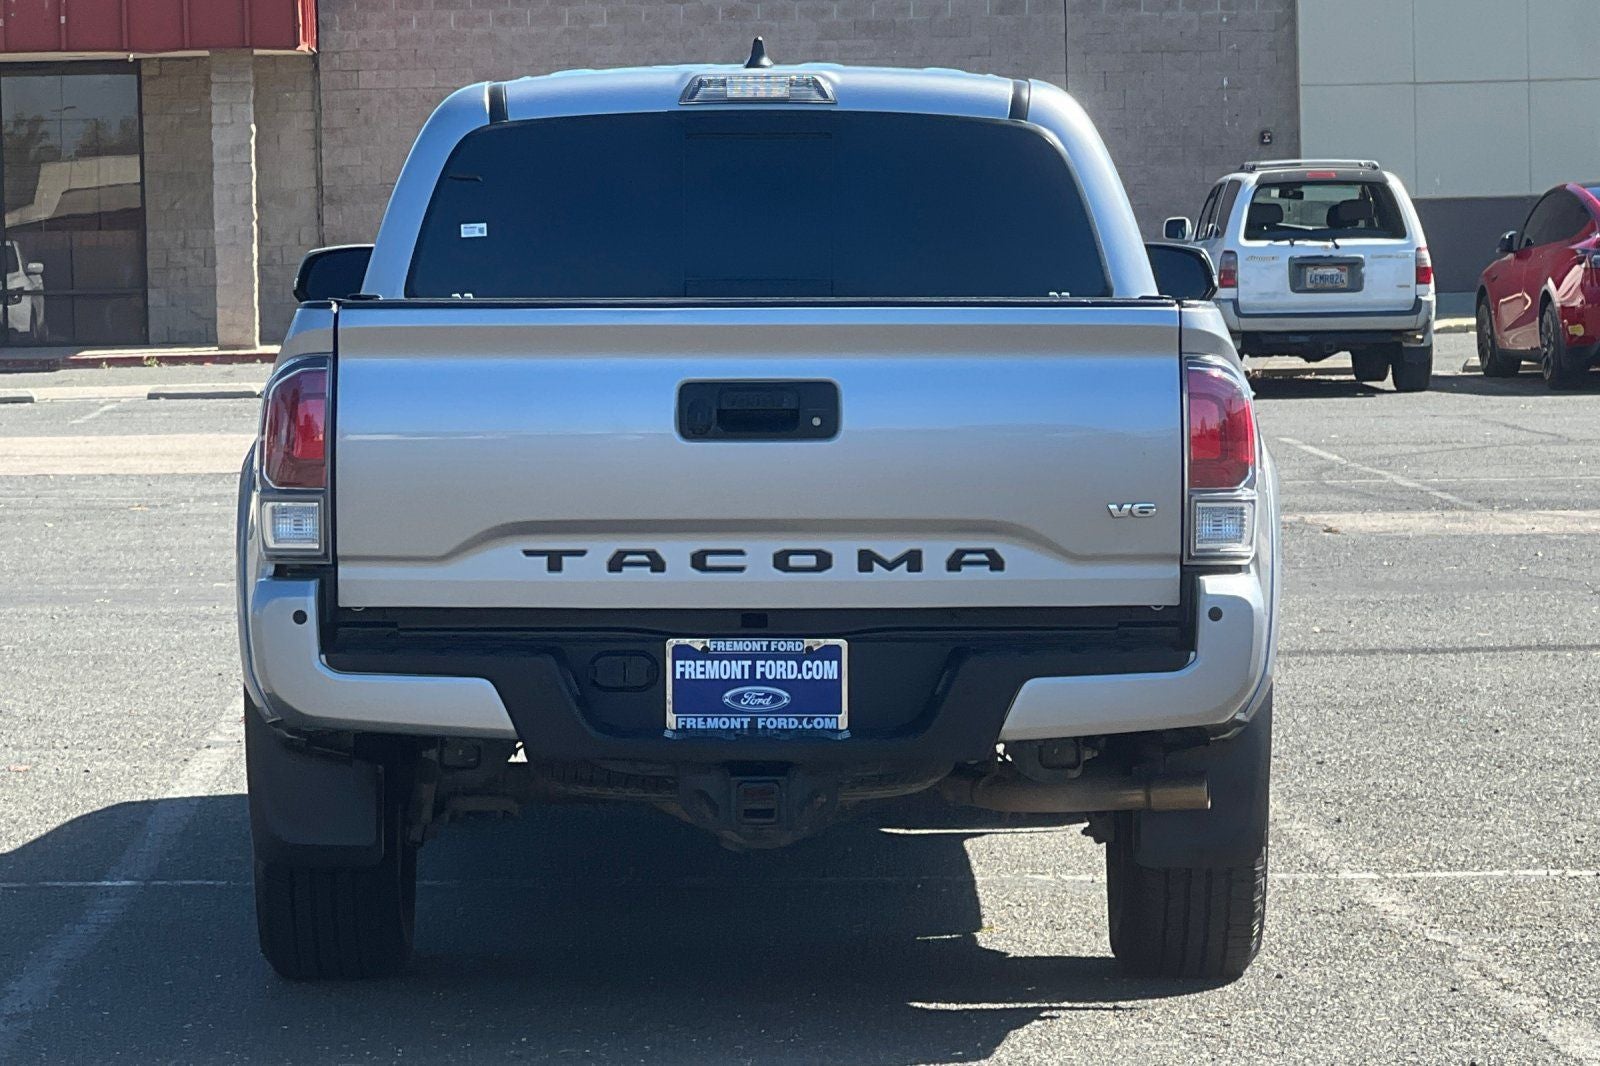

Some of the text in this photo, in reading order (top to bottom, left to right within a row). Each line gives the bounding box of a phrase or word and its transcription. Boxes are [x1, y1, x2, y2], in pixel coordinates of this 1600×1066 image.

[1107, 503, 1156, 517] V6
[521, 548, 1005, 573] TACOMA
[709, 641, 804, 652] FREMONT FORD
[676, 660, 838, 680] FREMONT FORD.COM
[741, 691, 773, 706] Ford
[678, 717, 837, 729] FREMONT FORD.COM
